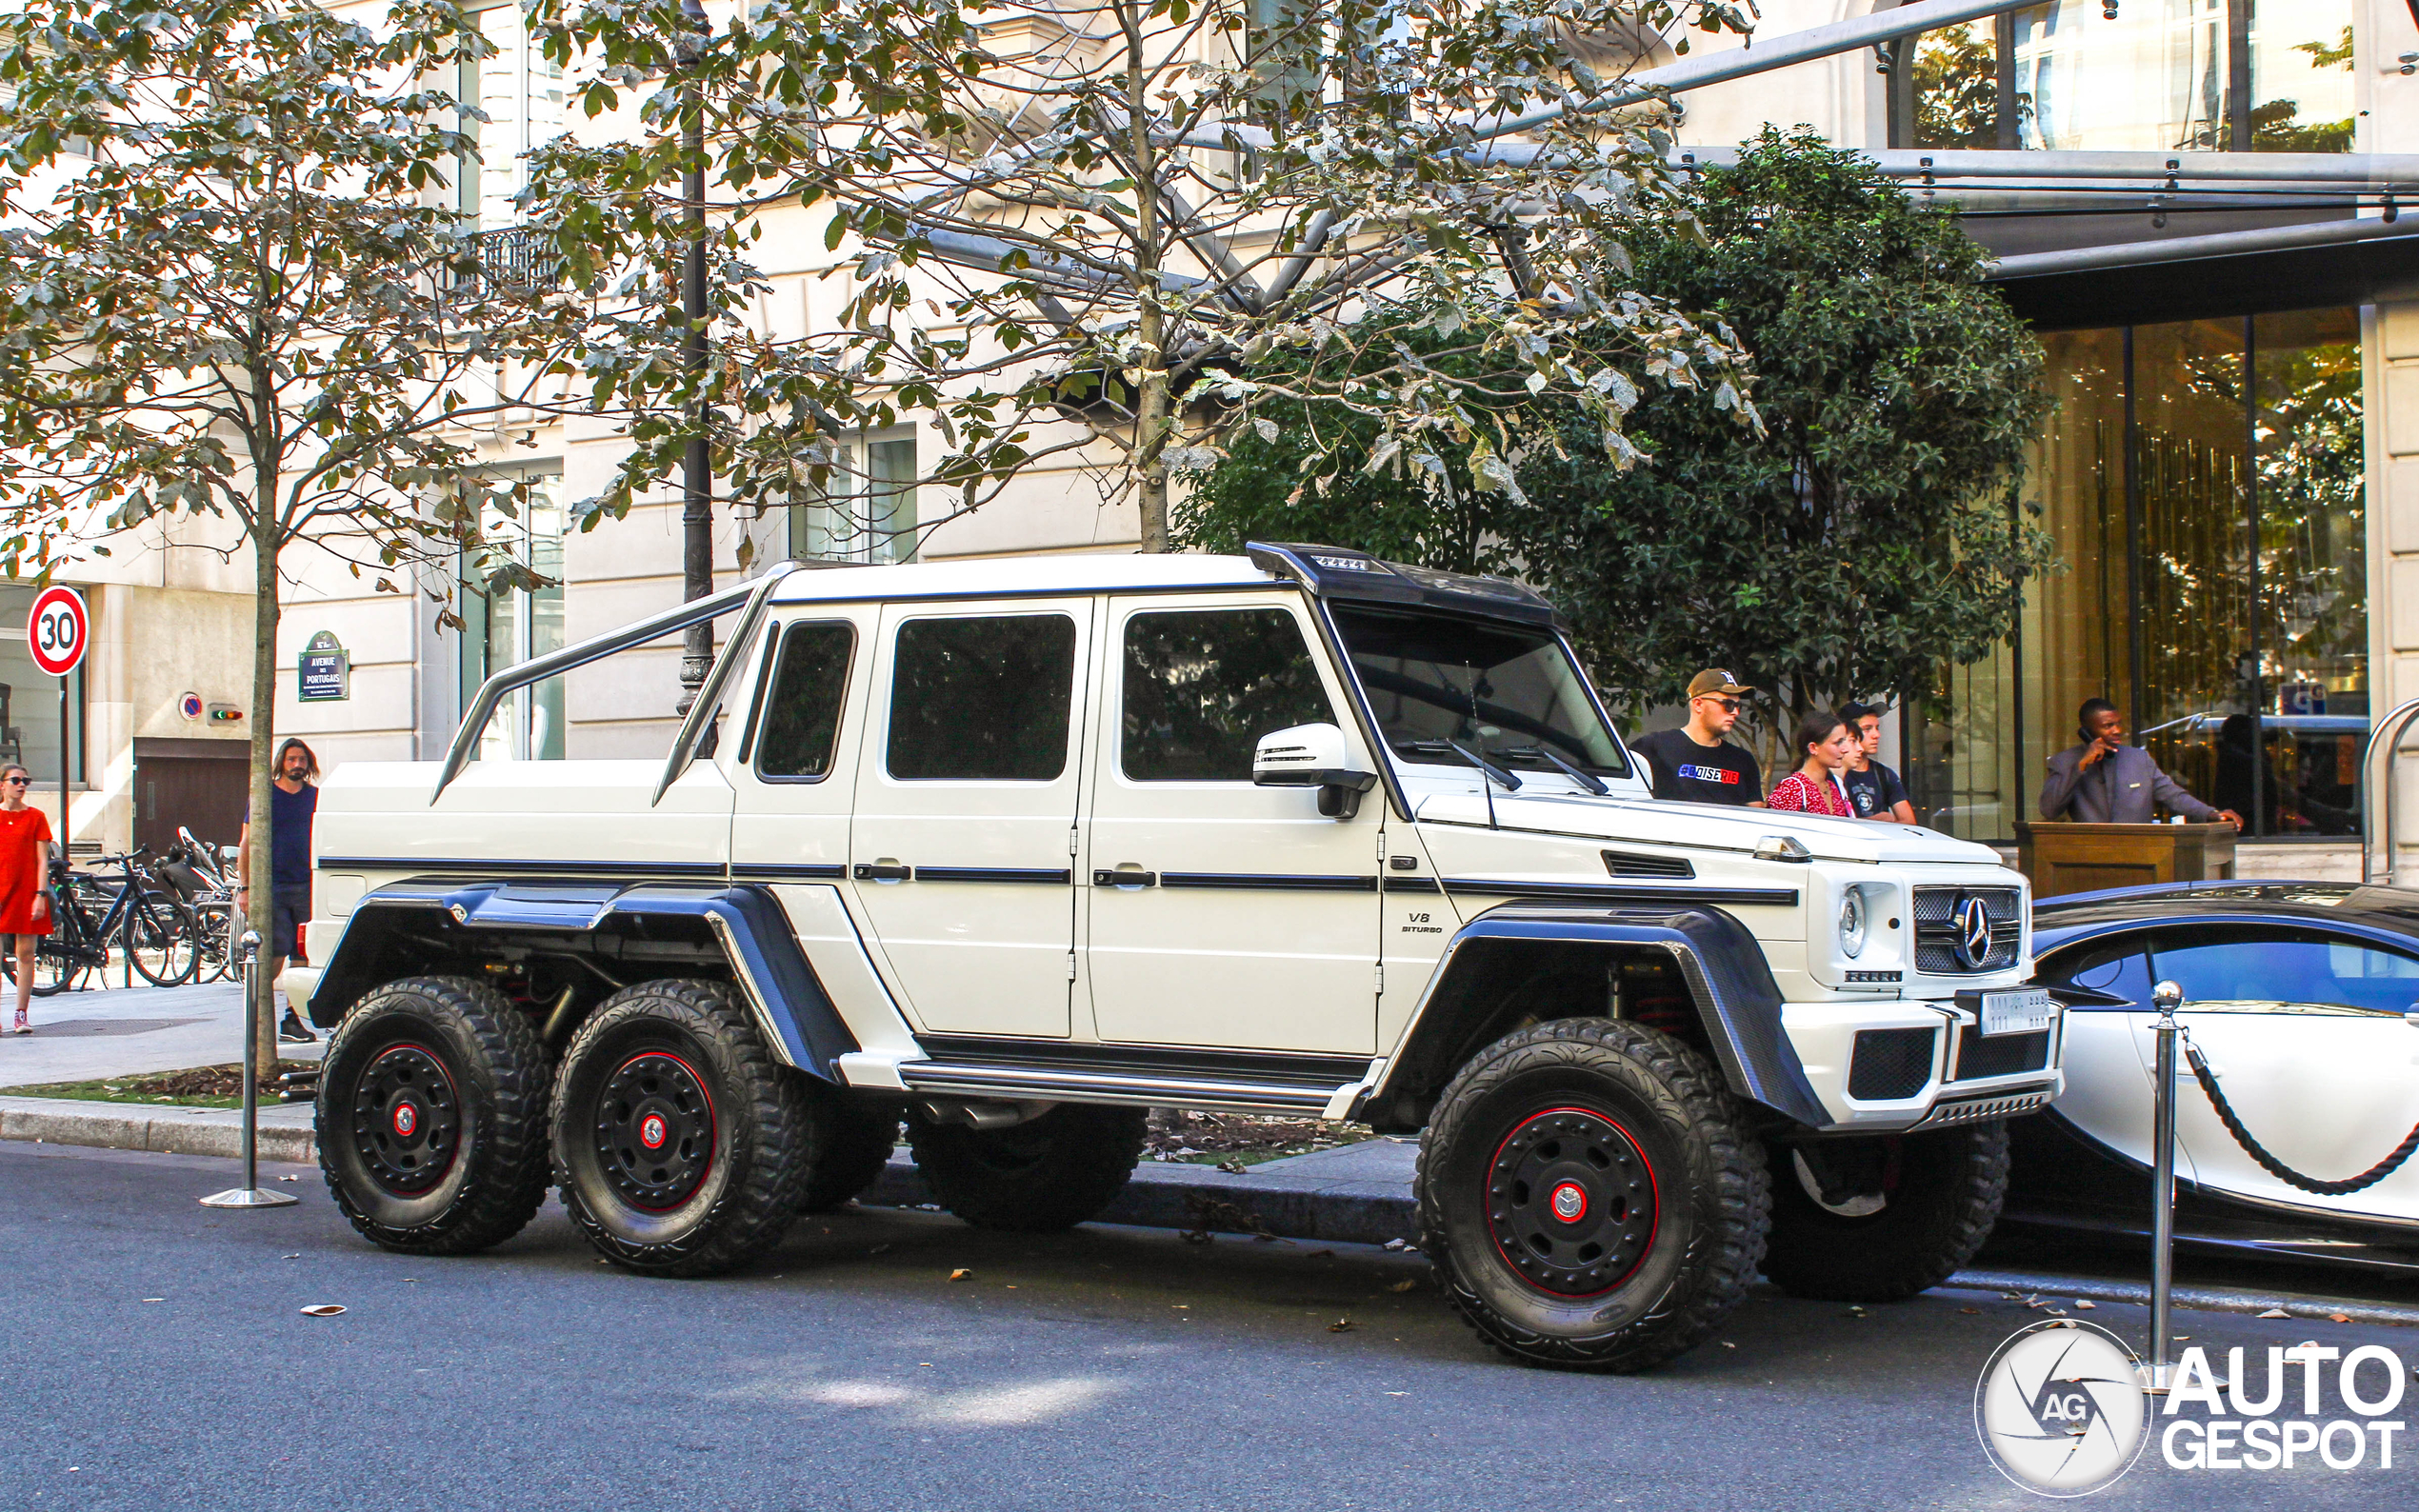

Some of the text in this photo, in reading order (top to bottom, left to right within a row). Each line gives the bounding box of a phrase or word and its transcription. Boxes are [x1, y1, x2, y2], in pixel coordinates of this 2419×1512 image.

[40, 611, 75, 651] 30
[311, 657, 336, 666] AVENUE
[306, 673, 340, 685] PORTUGAIS
[1409, 912, 1430, 923] V8
[1401, 925, 1443, 934] BITURBO
